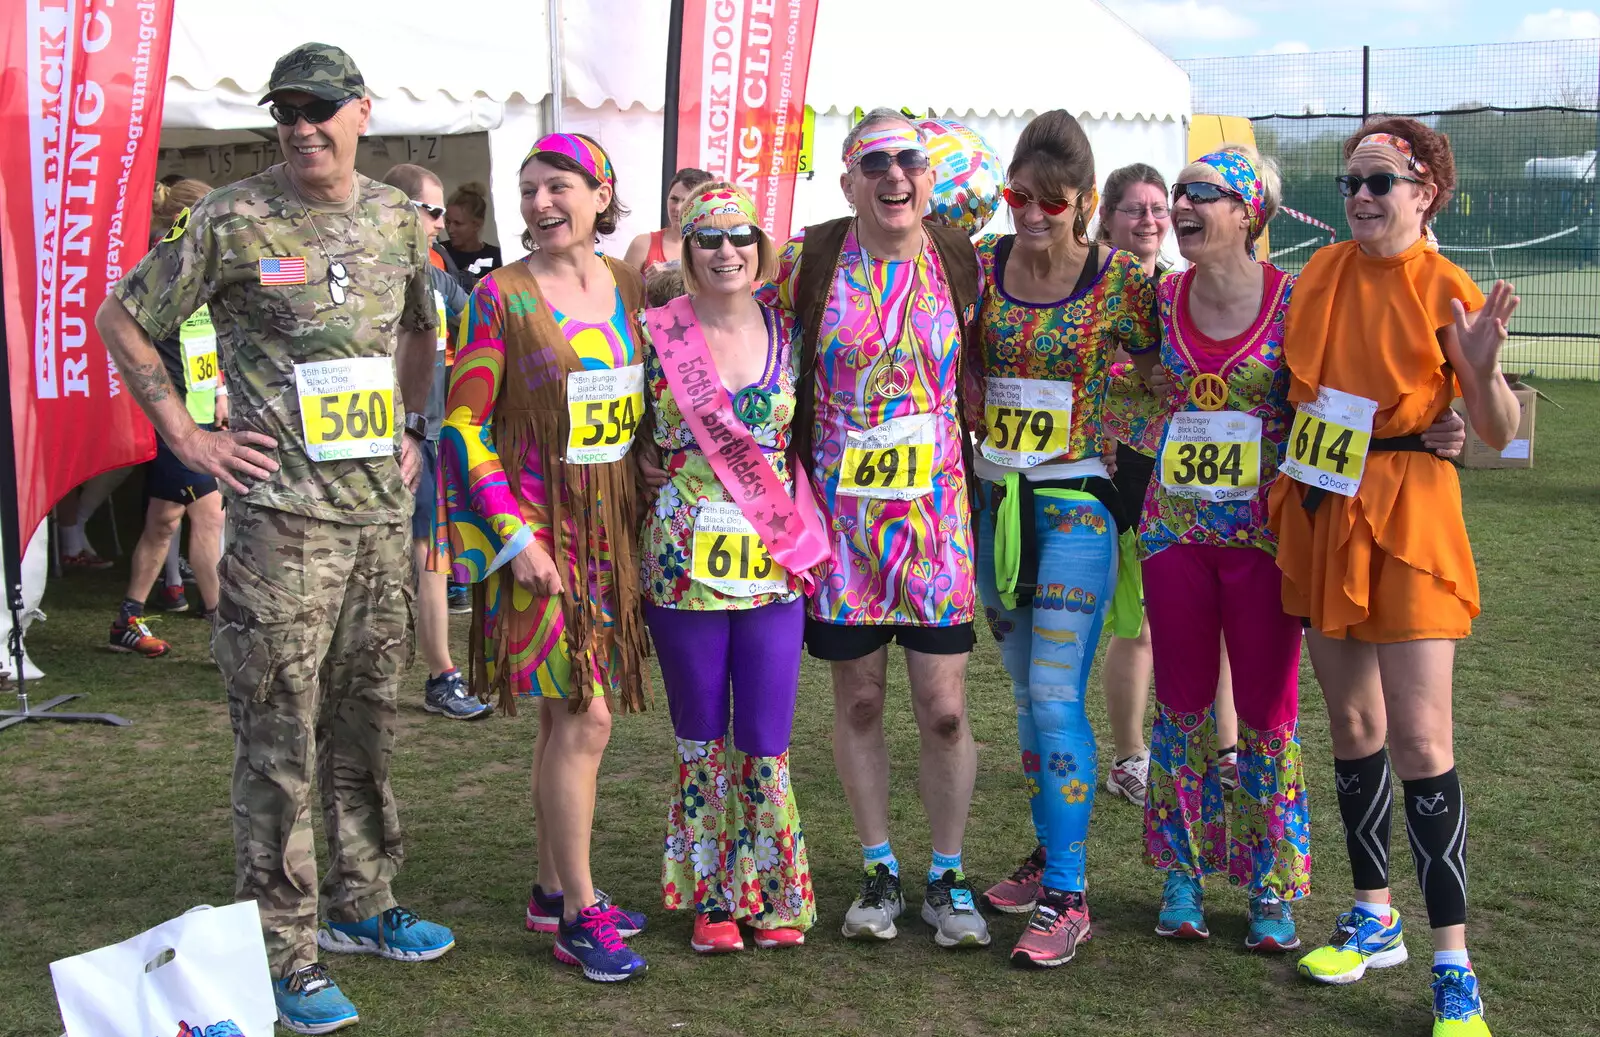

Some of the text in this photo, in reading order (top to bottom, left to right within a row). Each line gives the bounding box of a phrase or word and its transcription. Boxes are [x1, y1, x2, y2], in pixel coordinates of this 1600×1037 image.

[711, 0, 736, 75] DOG
[41, 26, 66, 184] BLACK
[62, 79, 105, 398] RUNNING
[301, 366, 351, 377] 35th Bungay
[306, 375, 348, 387] Black Dog
[999, 382, 1022, 392] Bungay
[577, 383, 614, 393] Black Dog
[569, 394, 584, 402] Half
[1006, 391, 1020, 400] Dog
[320, 391, 388, 441] 560
[582, 396, 636, 446] 554
[1186, 416, 1211, 425] Bungay
[677, 355, 767, 502] 50th Birthday
[994, 407, 1054, 451] 579
[1192, 426, 1207, 435] Dog
[1168, 434, 1182, 442] Half
[1295, 416, 1354, 474] 614
[318, 448, 353, 460] NSPCC
[576, 452, 608, 462] NSPCC
[985, 453, 1013, 465] NSPCC
[854, 446, 917, 487] 691
[1173, 443, 1243, 486] 384
[703, 515, 742, 525] Black Dog
[711, 525, 748, 533] Marathon
[707, 534, 773, 579] 613
[1033, 583, 1097, 615] EACE
